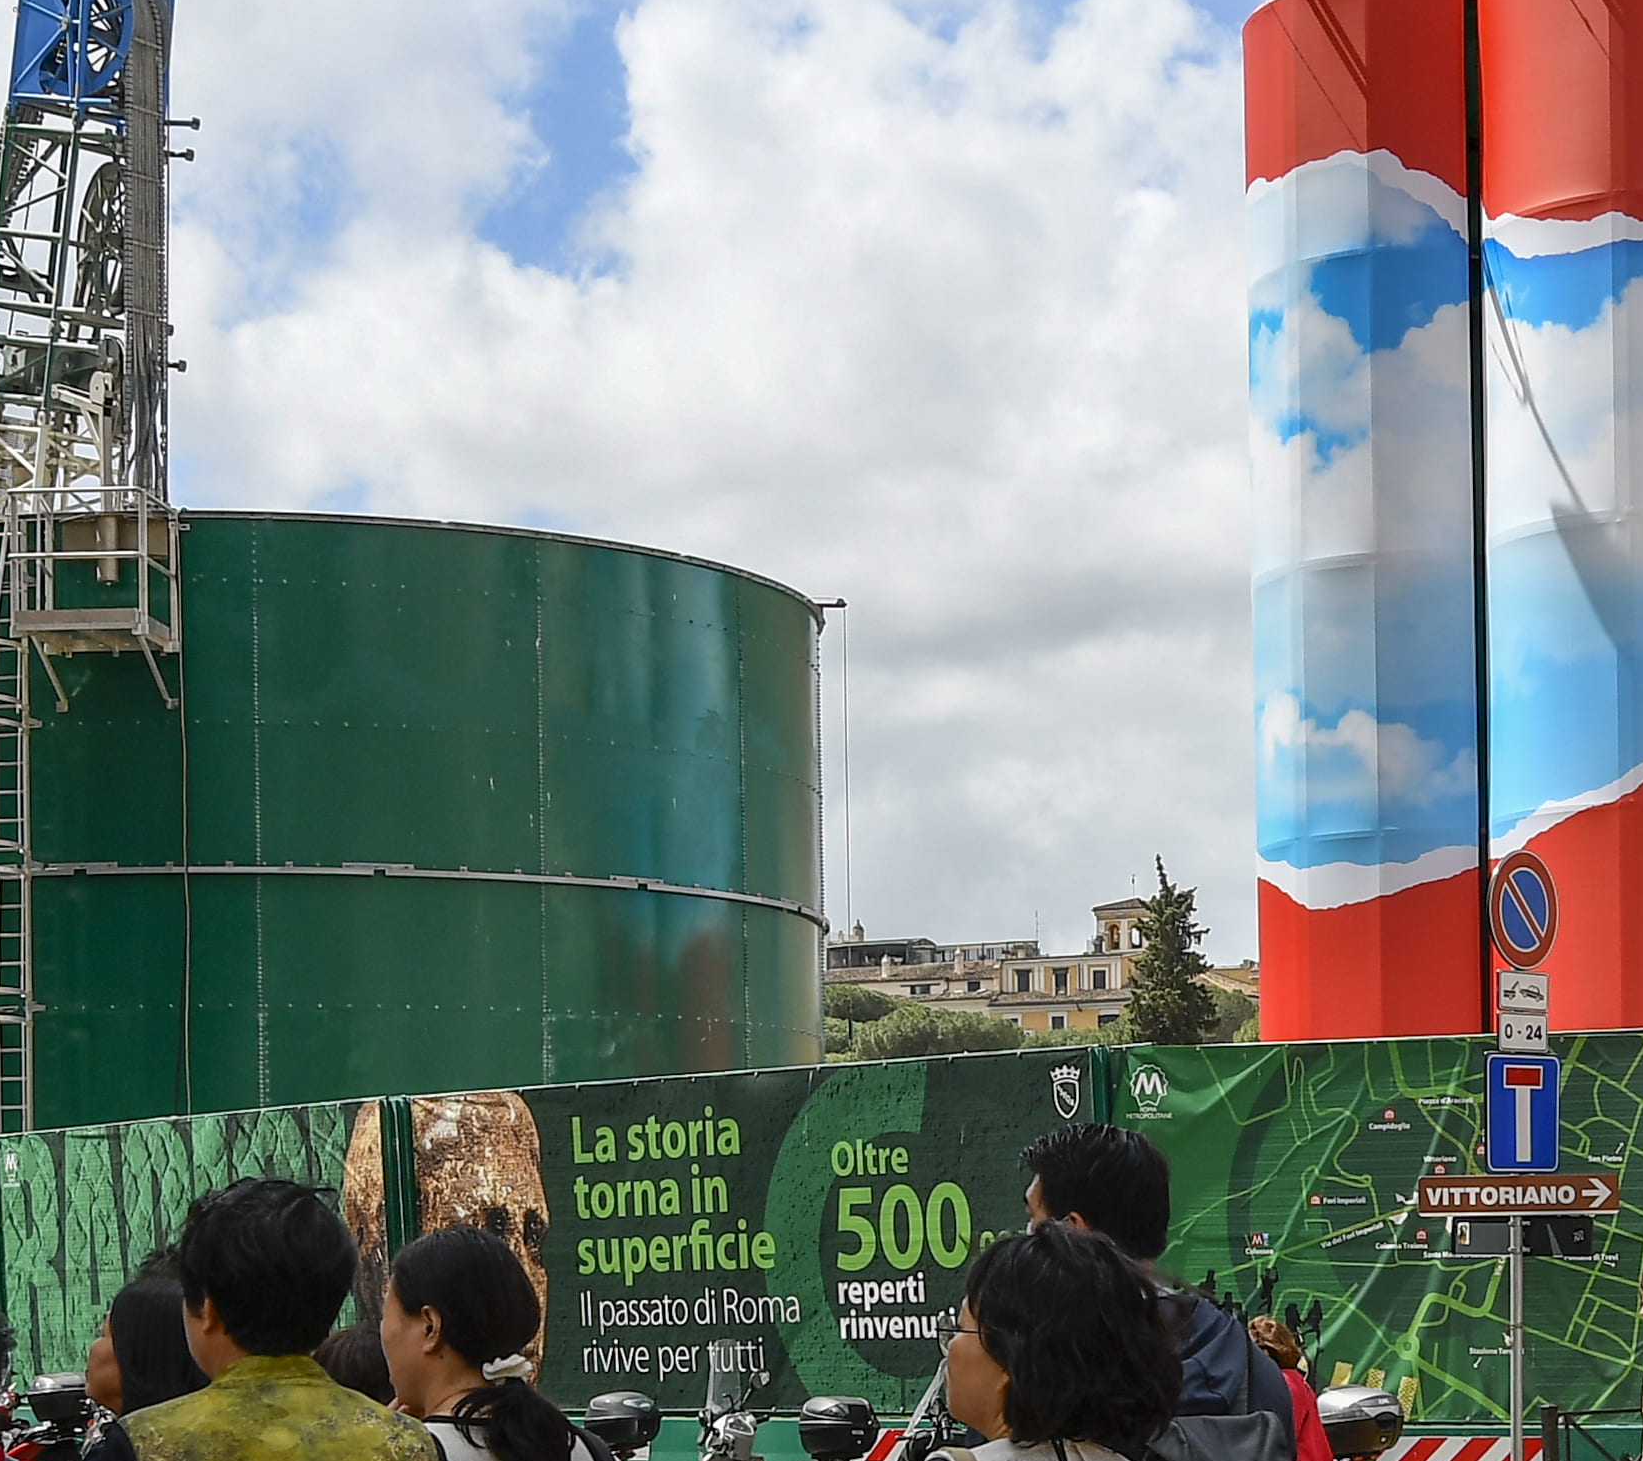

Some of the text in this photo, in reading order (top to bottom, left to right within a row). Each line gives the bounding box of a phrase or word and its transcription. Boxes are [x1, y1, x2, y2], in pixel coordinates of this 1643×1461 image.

[1525, 1025, 1543, 1042] 24
[1418, 1096, 1439, 1106] Piazza
[570, 1104, 741, 1165] La storia
[1368, 1122, 1411, 1132] Campidoglio
[830, 1139, 909, 1178] Oltre
[1423, 1155, 1457, 1164] Vittoriano
[1588, 1155, 1623, 1163] San Pietro
[573, 1162, 728, 1220] torna in
[1426, 1184, 1576, 1206] VITTORIANO
[1323, 1196, 1366, 1206] Fori Imperiali
[835, 1181, 973, 1272] 500
[1320, 1240, 1331, 1249] Via
[1342, 1231, 1356, 1242] Fori
[1356, 1221, 1384, 1238] Imperiali
[576, 1217, 777, 1286] superficie
[1399, 1241, 1429, 1251] Traiana
[1423, 1250, 1441, 1259] Santa
[1601, 1253, 1619, 1262] Trevi
[837, 1272, 926, 1312] reperti
[579, 1286, 802, 1334] Il passato di Roma
[582, 1337, 766, 1381] rivive per tutti
[1469, 1347, 1498, 1356] Stazione
